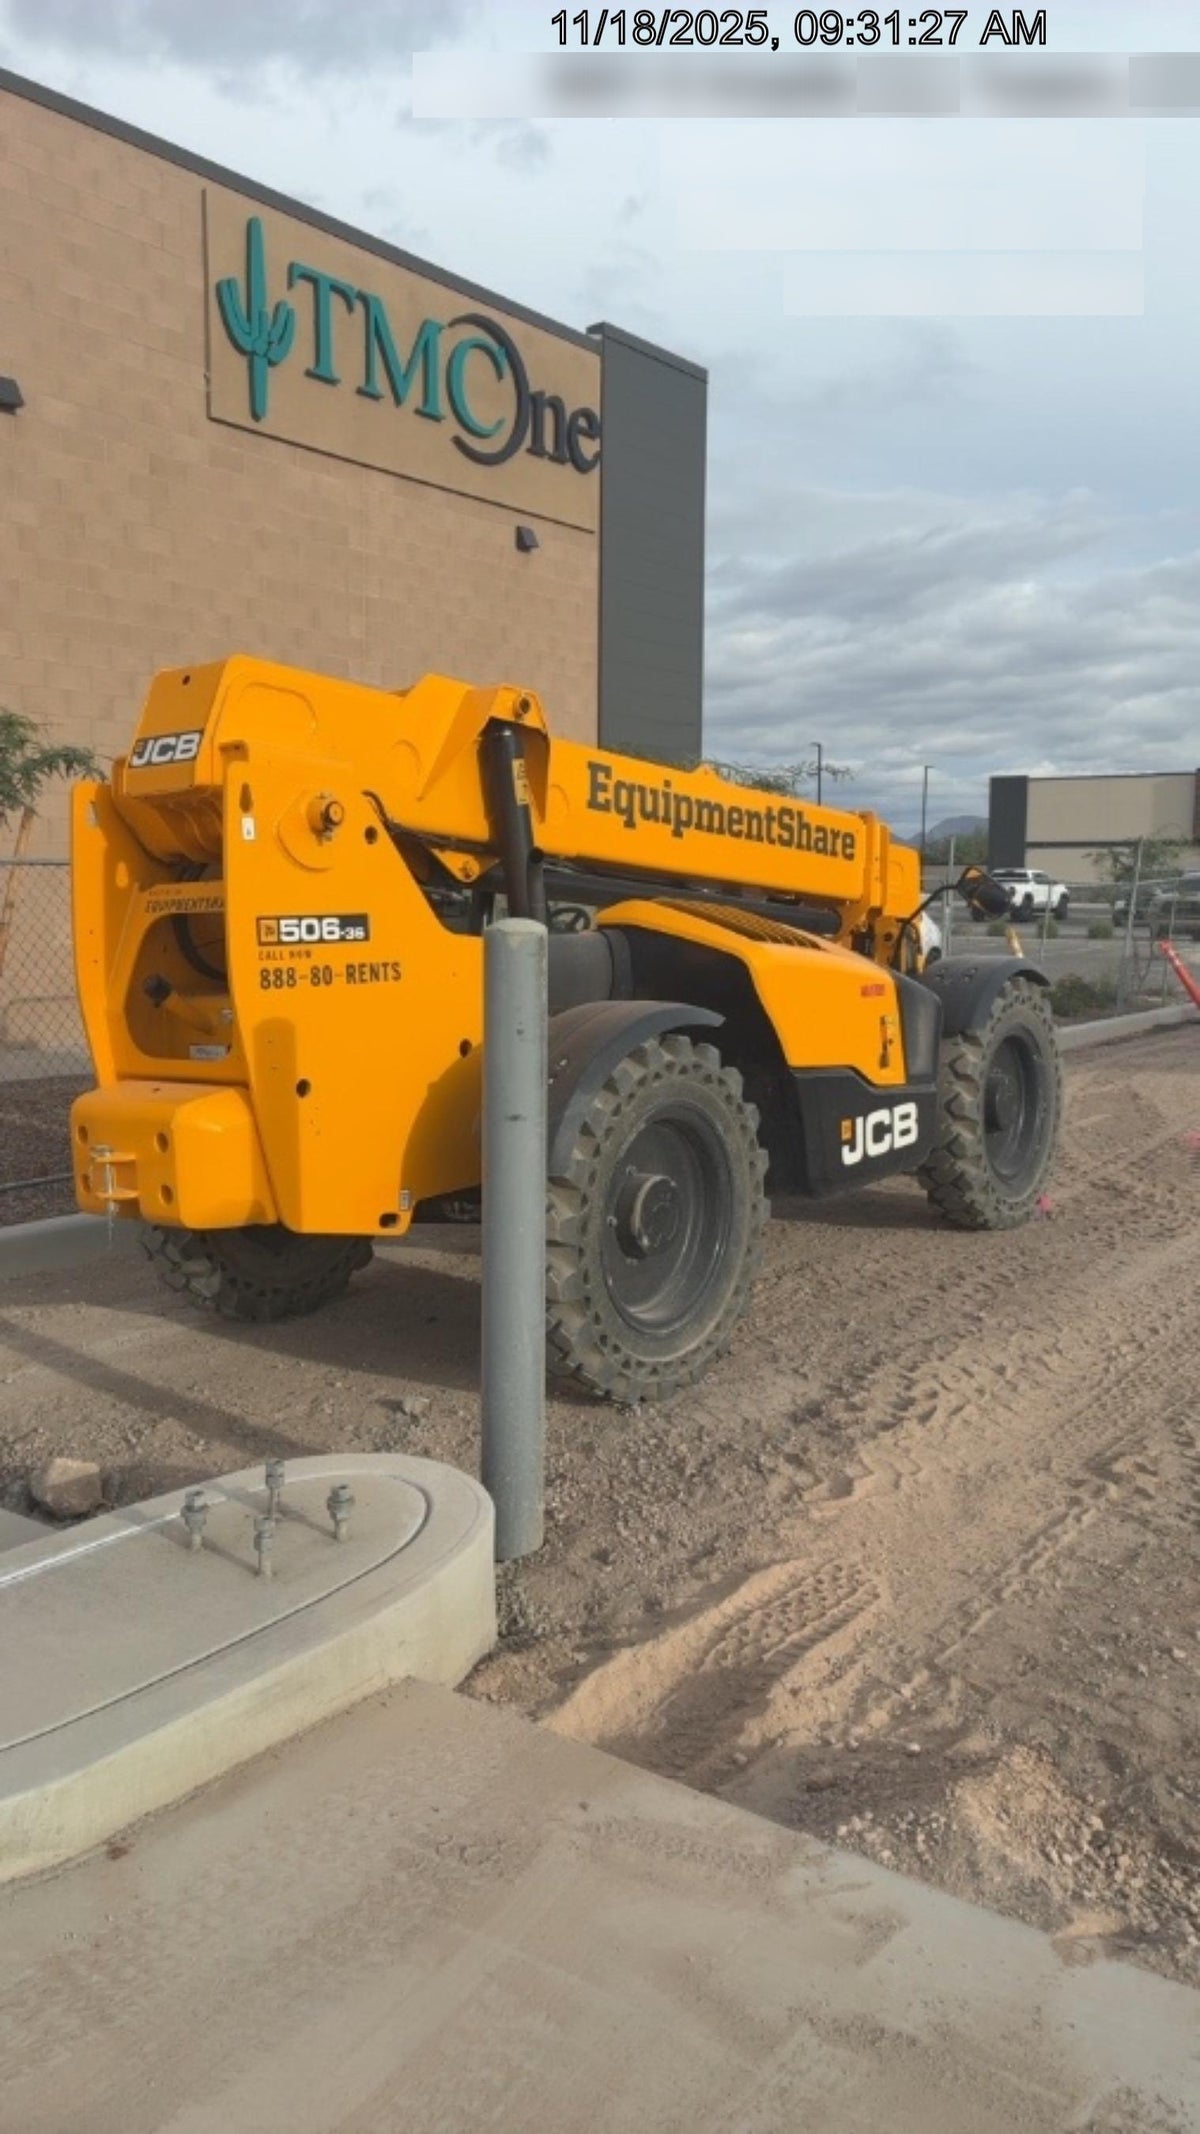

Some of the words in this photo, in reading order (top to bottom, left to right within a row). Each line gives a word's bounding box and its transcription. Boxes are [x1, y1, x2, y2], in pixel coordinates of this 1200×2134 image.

[131, 732, 201, 767] JCB
[587, 760, 856, 861] EquipmentShare
[258, 950, 284, 961] CALL
[260, 962, 402, 990] 888-80-RENTS
[841, 1102, 918, 1166] JCB
